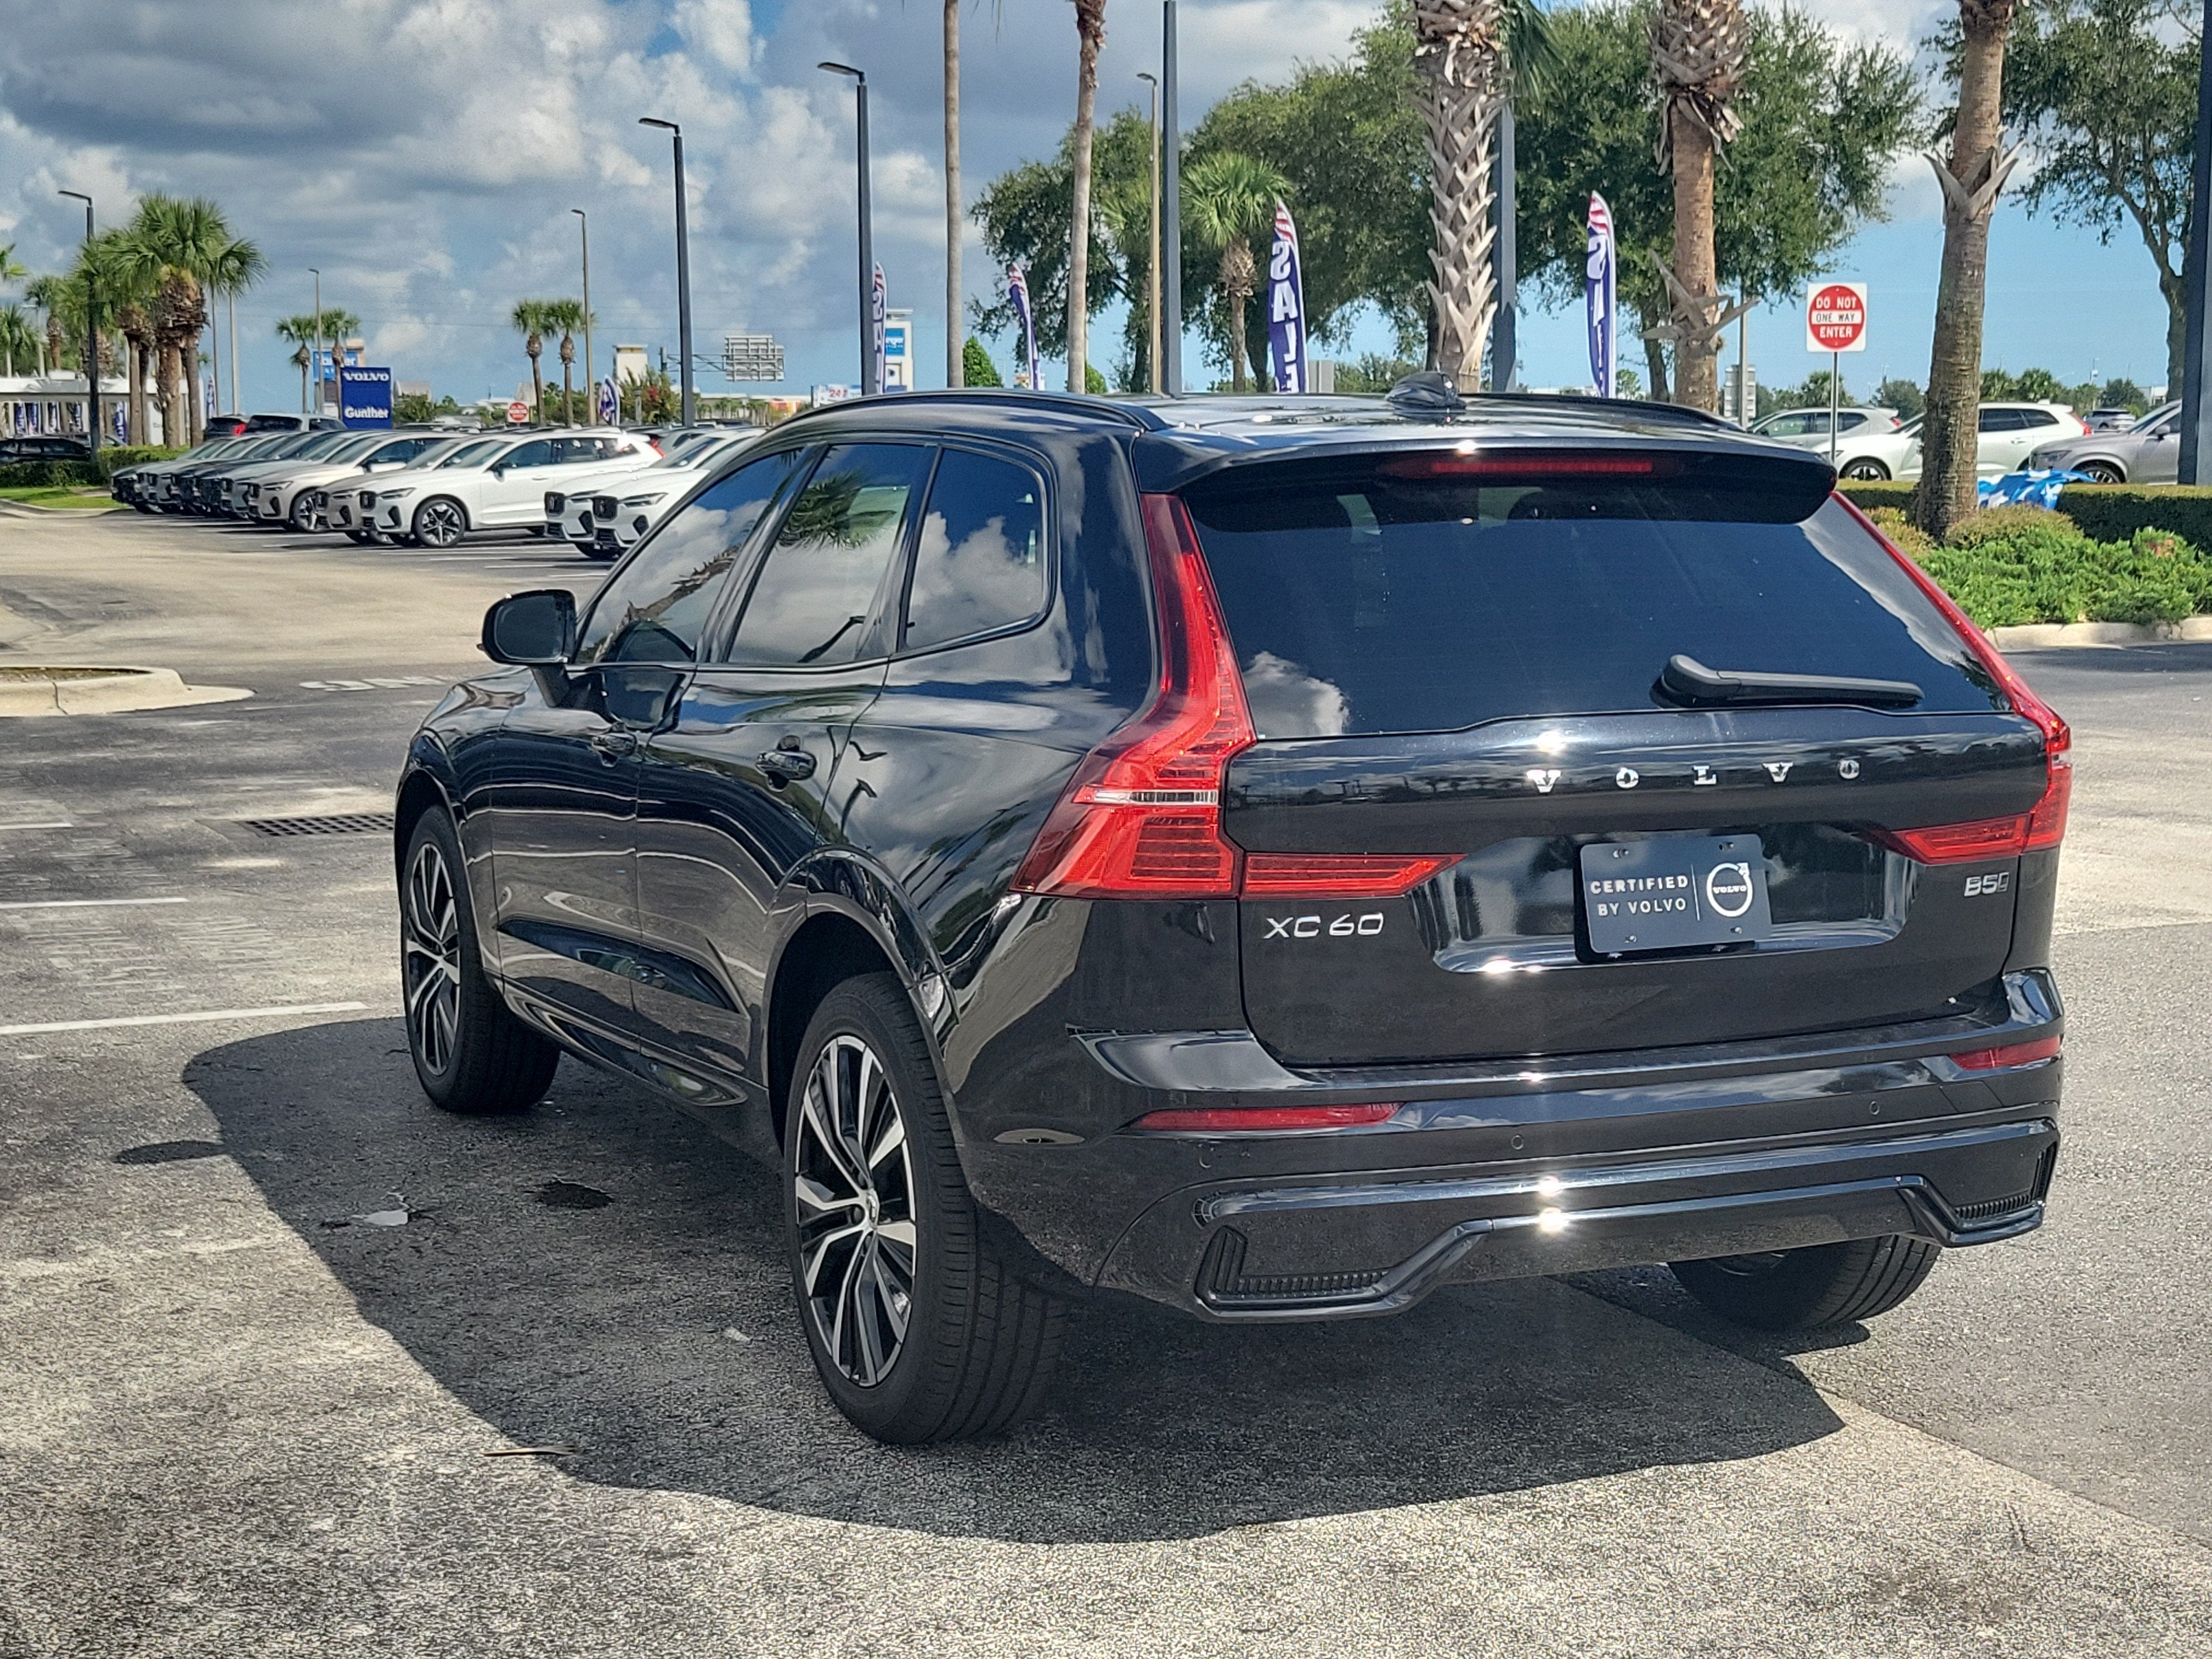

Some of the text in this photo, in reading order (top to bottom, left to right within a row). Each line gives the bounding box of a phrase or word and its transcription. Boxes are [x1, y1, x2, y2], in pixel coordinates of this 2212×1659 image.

[1816, 296, 1857, 309] DO NOT
[1816, 312, 1855, 323] ONE WAY
[1820, 326, 1853, 338] ENTER
[343, 371, 390, 381] VOLVO
[345, 405, 389, 419] Gunther
[1526, 758, 1860, 794] VOLVO
[1590, 875, 1688, 894] CERTIFIED
[1712, 884, 1747, 894] VOLVO
[1597, 898, 1686, 917] BY VOLVO
